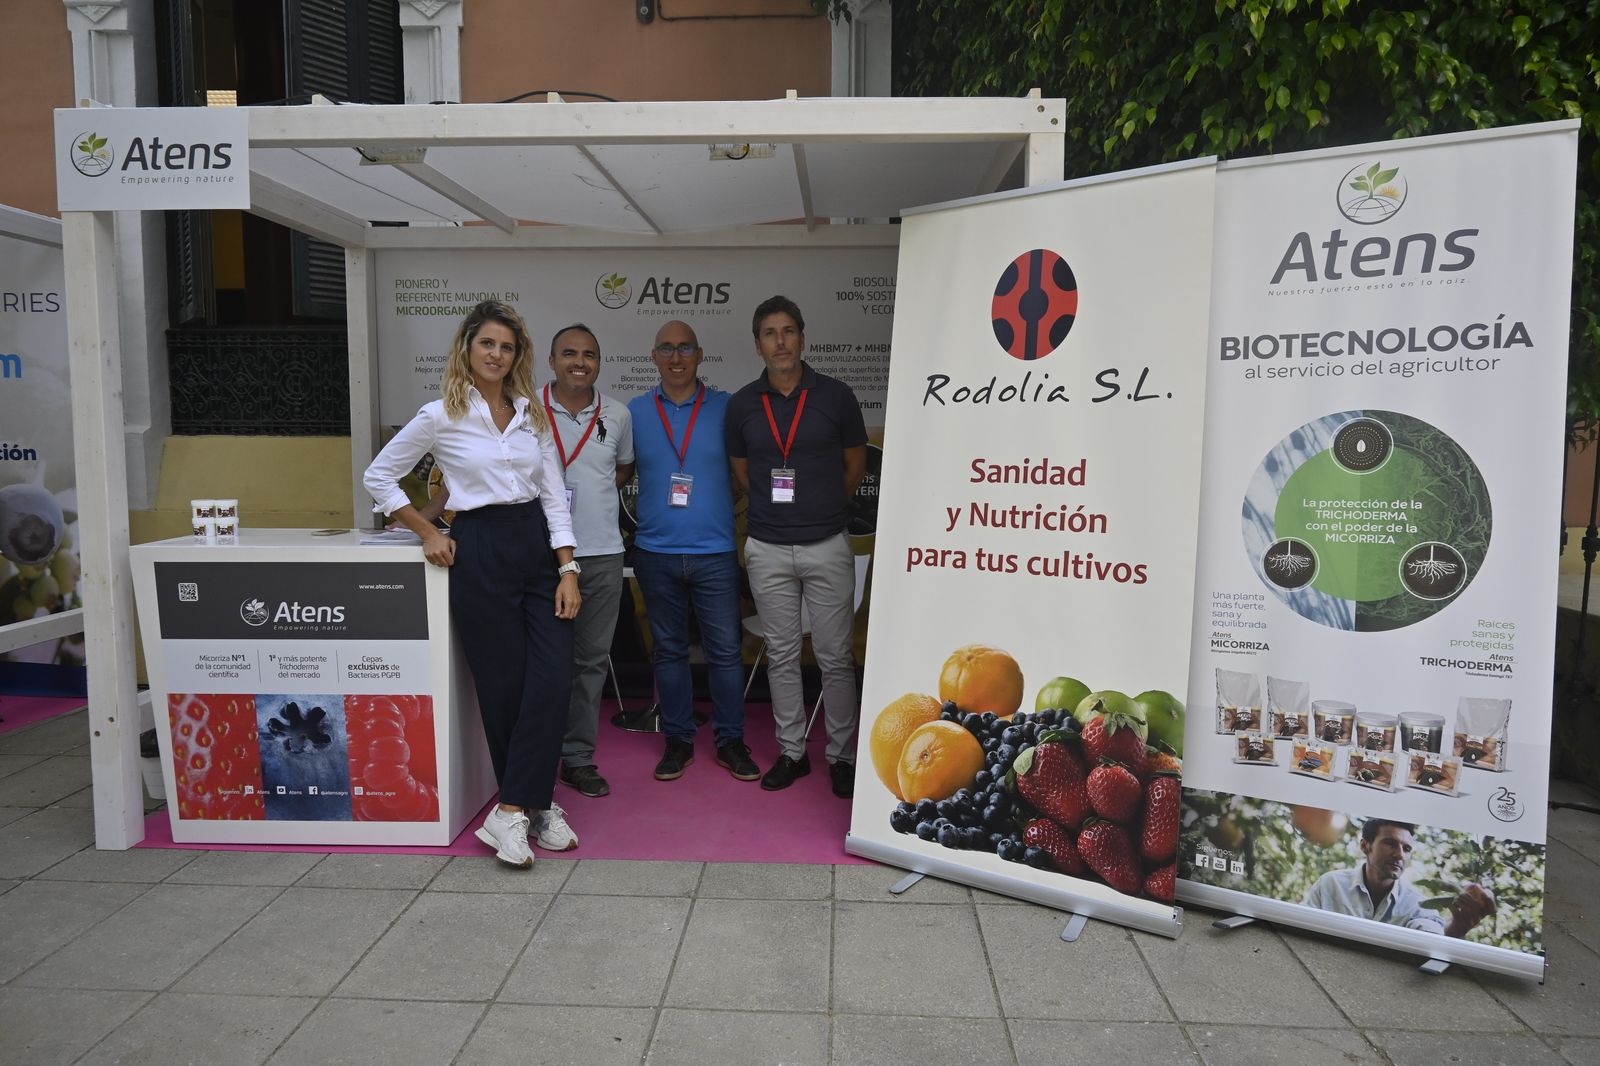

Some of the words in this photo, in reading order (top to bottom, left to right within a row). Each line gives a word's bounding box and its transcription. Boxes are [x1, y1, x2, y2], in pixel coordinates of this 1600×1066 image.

[121, 137, 232, 170] Atens
[121, 175, 190, 185] Empowering
[195, 175, 234, 184] nature
[1269, 228, 1479, 285] Atens
[395, 279, 440, 289] PIONERO
[441, 279, 449, 289] Y
[637, 276, 731, 305] Atens
[836, 290, 865, 301] 100%
[1267, 288, 1314, 297] Nuestra
[1320, 285, 1360, 294] fuerza
[0, 292, 60, 313] RIES
[395, 292, 452, 303] REFERENTE
[454, 291, 501, 302] MUNDIAL
[505, 291, 519, 302] EN
[636, 308, 695, 316] Empowering
[700, 308, 732, 316] nature
[862, 304, 869, 315] Y
[1220, 313, 1534, 361] BIOTECNOLOGÍA
[809, 344, 853, 353] MHBM77
[1245, 364, 1262, 379] al
[1266, 361, 1345, 378] servicio
[1350, 360, 1383, 376] del
[1389, 356, 1501, 378] agricultor
[923, 370, 1070, 407] Rodolia
[1091, 366, 1173, 403] S.L.
[970, 457, 1087, 486] Sanidad
[1303, 498, 1316, 508] La
[1319, 499, 1388, 509] protección
[1391, 499, 1408, 509] de
[1411, 500, 1423, 510] la
[945, 507, 962, 532] y
[969, 502, 1108, 534] Nutrición
[1315, 510, 1408, 521] TRICHODERMA
[1305, 522, 1328, 531] con
[1331, 521, 1342, 531] el
[1344, 522, 1383, 533] poder
[1386, 523, 1403, 533] de
[1406, 523, 1418, 533] la
[1325, 533, 1395, 544] MICORRIZA
[906, 546, 967, 573] para
[975, 548, 1019, 574] tus
[1026, 550, 1148, 585] cultivos
[1212, 591, 1231, 600] Una
[1233, 592, 1265, 602] planta
[1212, 601, 1233, 609] más
[273, 601, 345, 623] Atens
[1236, 612, 1242, 620] y
[273, 624, 319, 632] Empowering
[1211, 620, 1267, 629] equilibrada
[1211, 631, 1232, 639] Atens
[1471, 630, 1506, 640] sanas
[1507, 632, 1515, 641] y
[1211, 639, 1270, 652] MICORRIZA
[1449, 639, 1515, 651] protegidas
[299, 656, 327, 664] potente
[361, 655, 383, 663] Cepas
[1489, 653, 1514, 662] Atens
[347, 663, 390, 671] exclusivas
[390, 663, 400, 671] de
[1420, 656, 1513, 673] TRICHODERMA
[278, 671, 289, 679] del
[290, 671, 321, 679] mercado
[347, 671, 380, 679] Bacterias
[381, 671, 401, 679] PGPB
[1497, 786, 1516, 806] 25
